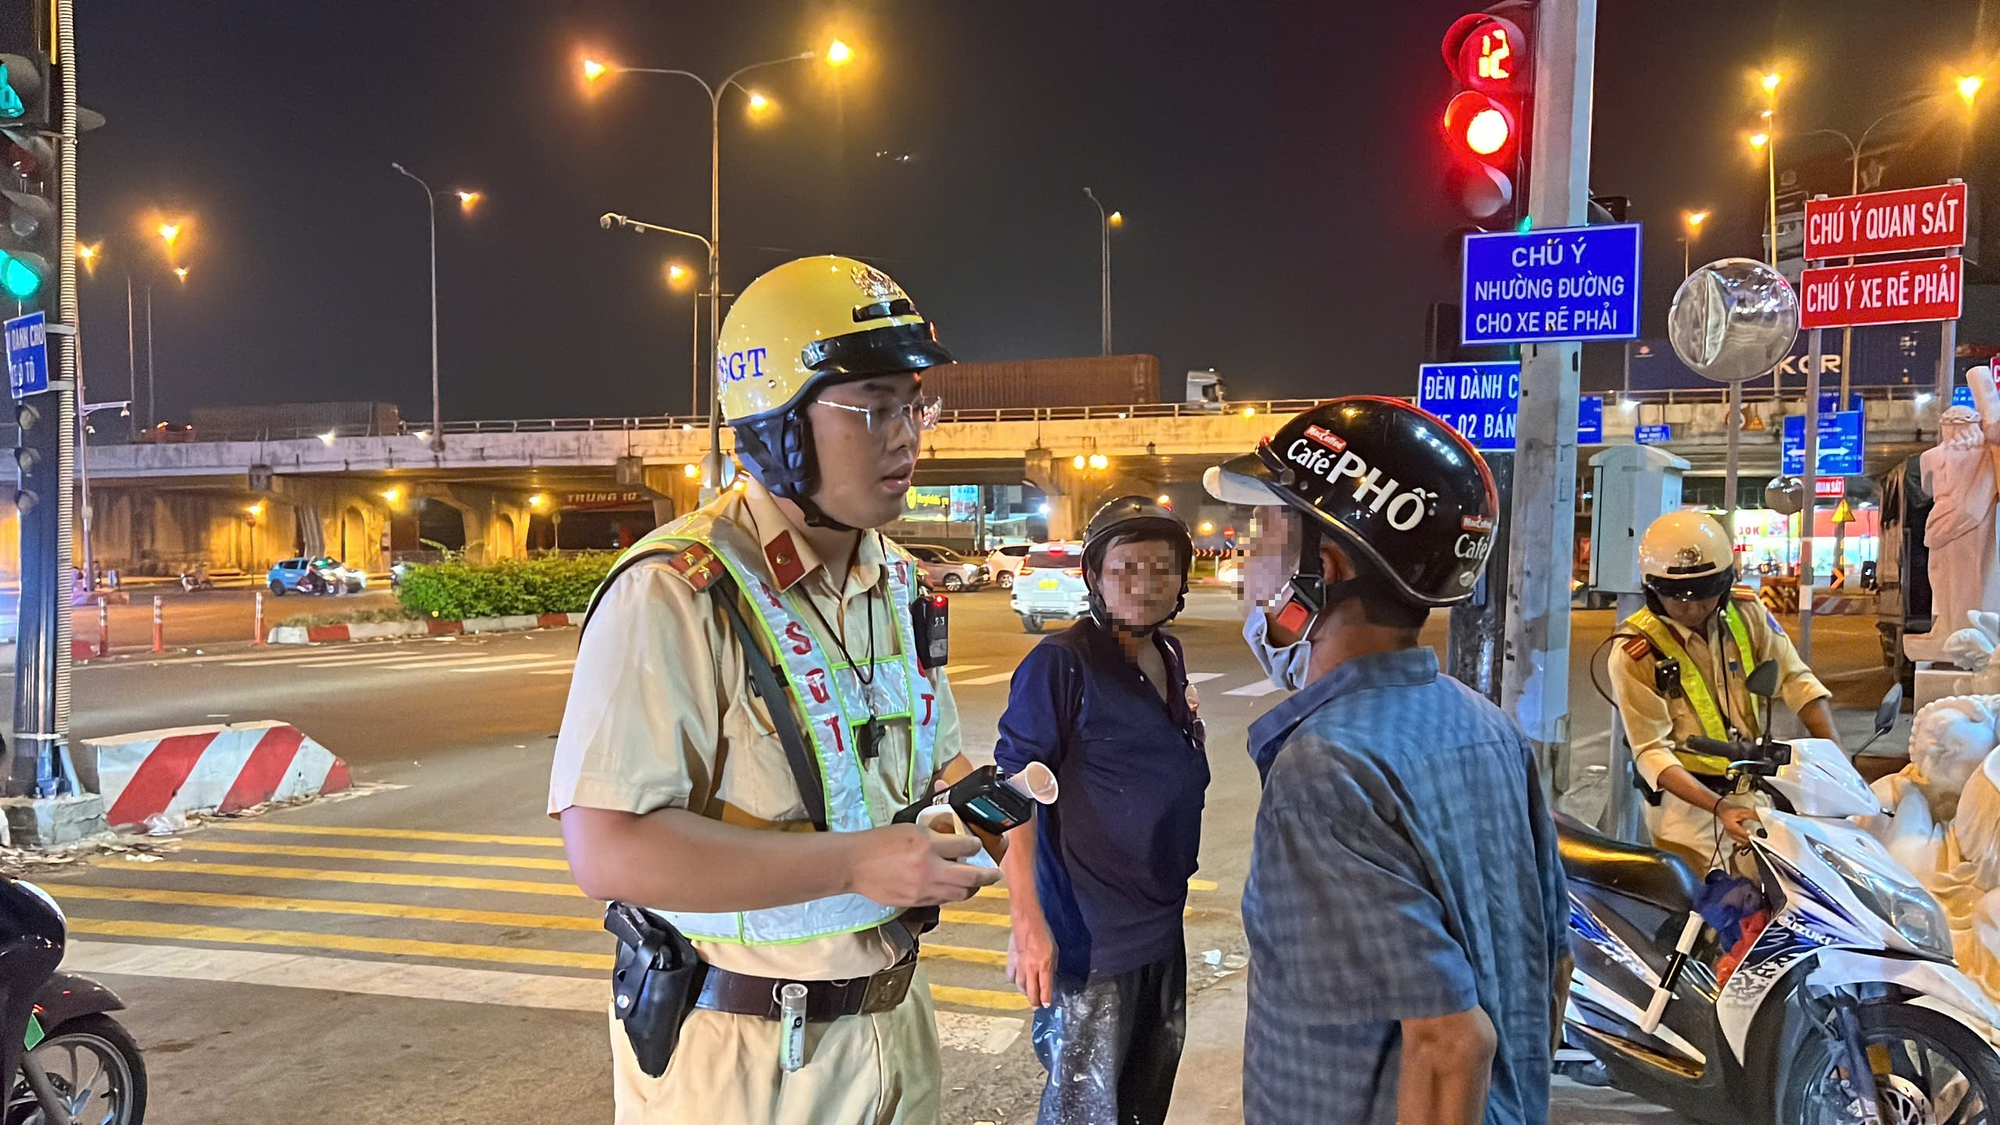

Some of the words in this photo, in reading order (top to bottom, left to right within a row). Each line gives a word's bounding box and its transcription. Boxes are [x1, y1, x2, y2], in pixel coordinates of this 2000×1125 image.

[1478, 29, 1510, 79] 12
[1809, 203, 1845, 245] CHÚ
[1849, 201, 1862, 242] Ý
[1866, 203, 1916, 240] QUAN
[1921, 192, 1959, 235] SÁT
[1511, 237, 1564, 268] CHÚ
[1571, 237, 1587, 264] Ý
[1475, 273, 1553, 301] NHƯỜNG
[1558, 270, 1625, 299] ĐƯỜNG
[1806, 274, 1839, 313] CHÚ
[1844, 273, 1856, 310] Ý
[1860, 277, 1883, 309] XE
[1886, 271, 1910, 308] RẼ
[1914, 263, 1956, 305] PHẢI
[1476, 312, 1512, 334] CHO
[1516, 312, 1540, 333] XE
[1545, 306, 1569, 332] RẼ
[1574, 301, 1618, 331] PHẢI
[1425, 369, 1456, 400] ĐÈN
[1460, 368, 1503, 399] DÀNH
[1458, 413, 1477, 440] 02
[567, 492, 617, 502] TRUNG
[1286, 438, 1337, 475] Café
[1325, 450, 1440, 531] PHỐ
[1454, 533, 1490, 560] Café
[1777, 912, 1833, 946] SUZUKI
